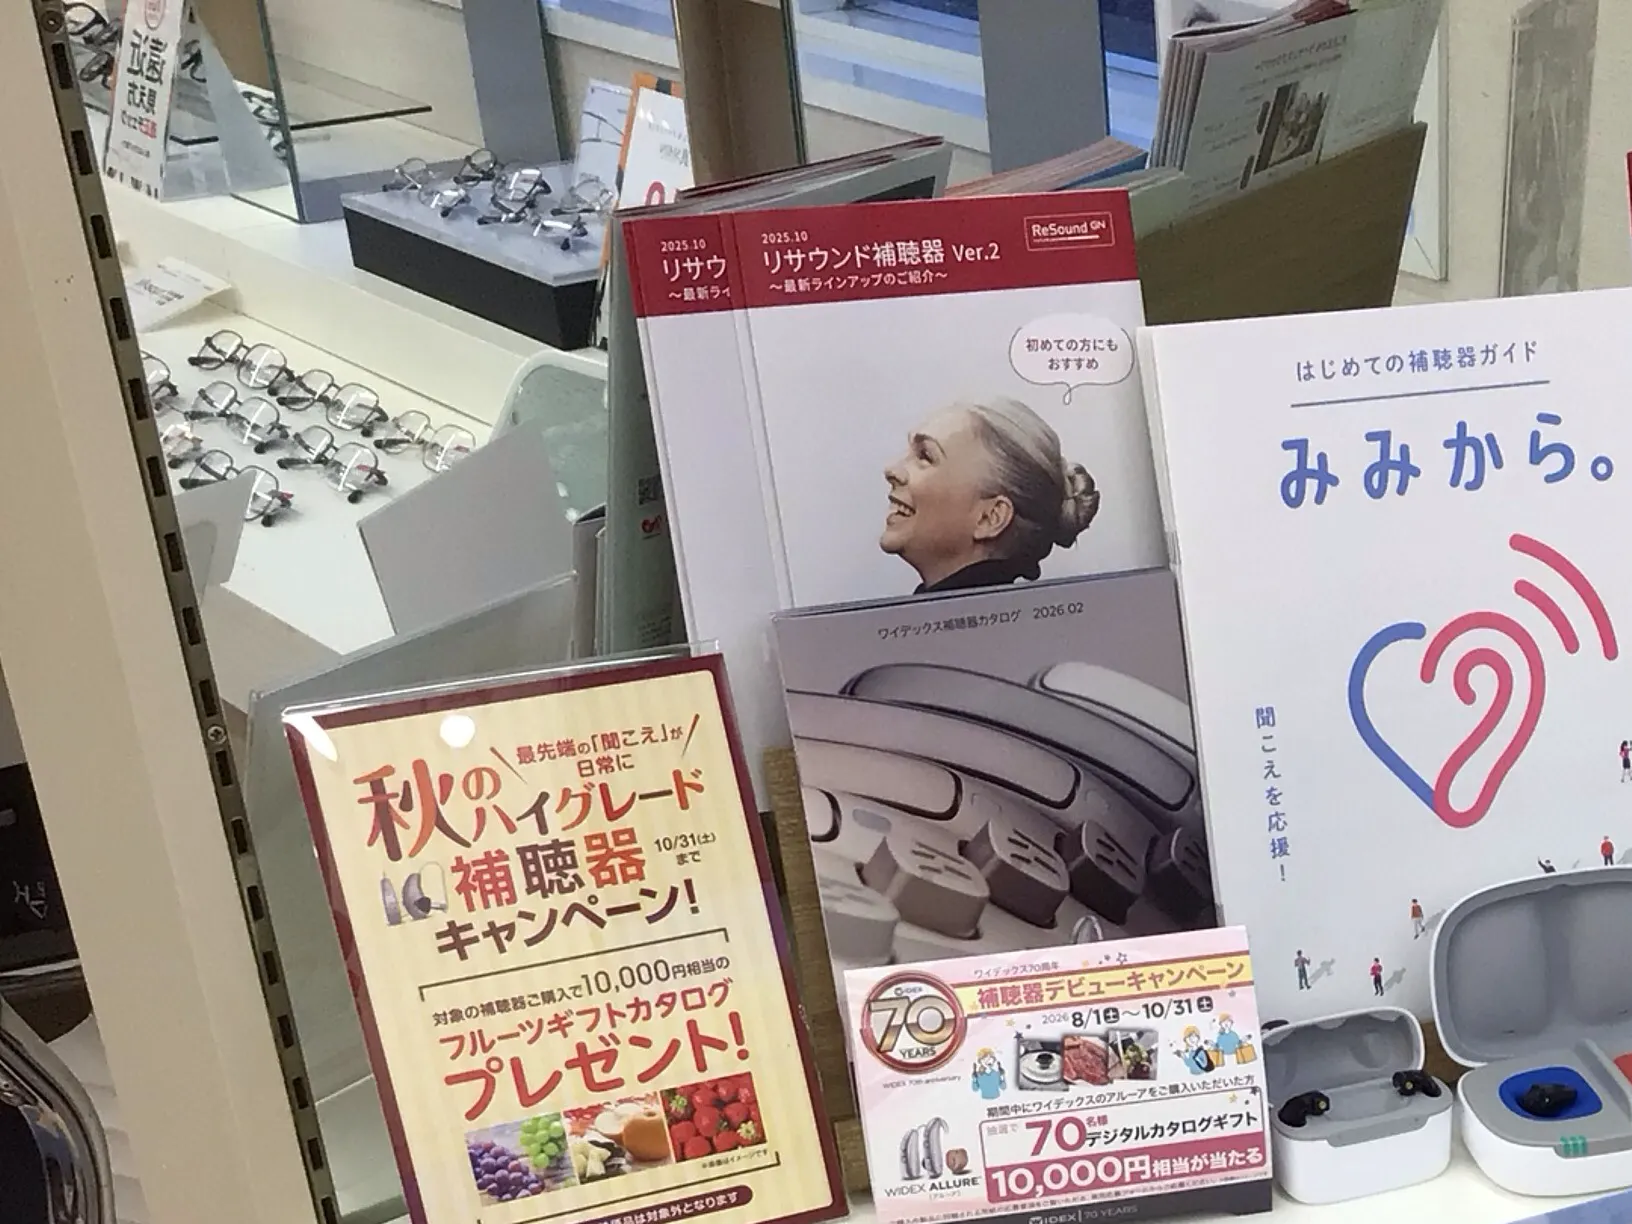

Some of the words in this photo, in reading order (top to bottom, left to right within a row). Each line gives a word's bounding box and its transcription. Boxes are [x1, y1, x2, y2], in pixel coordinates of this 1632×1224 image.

[661, 238, 706, 253] 2025.10
[761, 230, 808, 244] 2025.10
[1031, 221, 1088, 237] ReSound
[1090, 219, 1107, 230] GN
[663, 255, 728, 281] リサウ
[763, 239, 945, 275] リサウンド補聴器
[952, 242, 1001, 264] Ver.2
[1025, 337, 1119, 354] 初めての方にも
[1047, 356, 1100, 372] おすすめ
[1295, 339, 1539, 384] はじめての補聴器ガイド
[1280, 411, 1614, 509] みみから。
[516, 725, 684, 766] 最先端の「聞こえ」が
[577, 754, 635, 778] 日常に
[353, 758, 501, 862] 秋の
[472, 768, 704, 842] ハイグレード
[654, 831, 716, 852] 10/31(土)
[676, 850, 702, 866] まで
[450, 827, 646, 913] 補聴器
[432, 956, 731, 1027] 対象の補聴器ご購入で10,000円相当の
[977, 961, 1245, 1009] 補聴器デビューキャンペーン
[439, 976, 735, 1061] フルーツギフトカタログ
[868, 994, 958, 1054] 70
[899, 1046, 937, 1060] YEARS
[986, 1074, 1255, 1118] 期間中にワイデックスのアルーアをご購入いただいた方
[1025, 1115, 1086, 1156] 70
[1086, 1111, 1258, 1147] デジタルカタログギフト
[884, 1183, 926, 1198] WIDEX
[991, 1146, 1264, 1198] 10,000円相当が当たる
